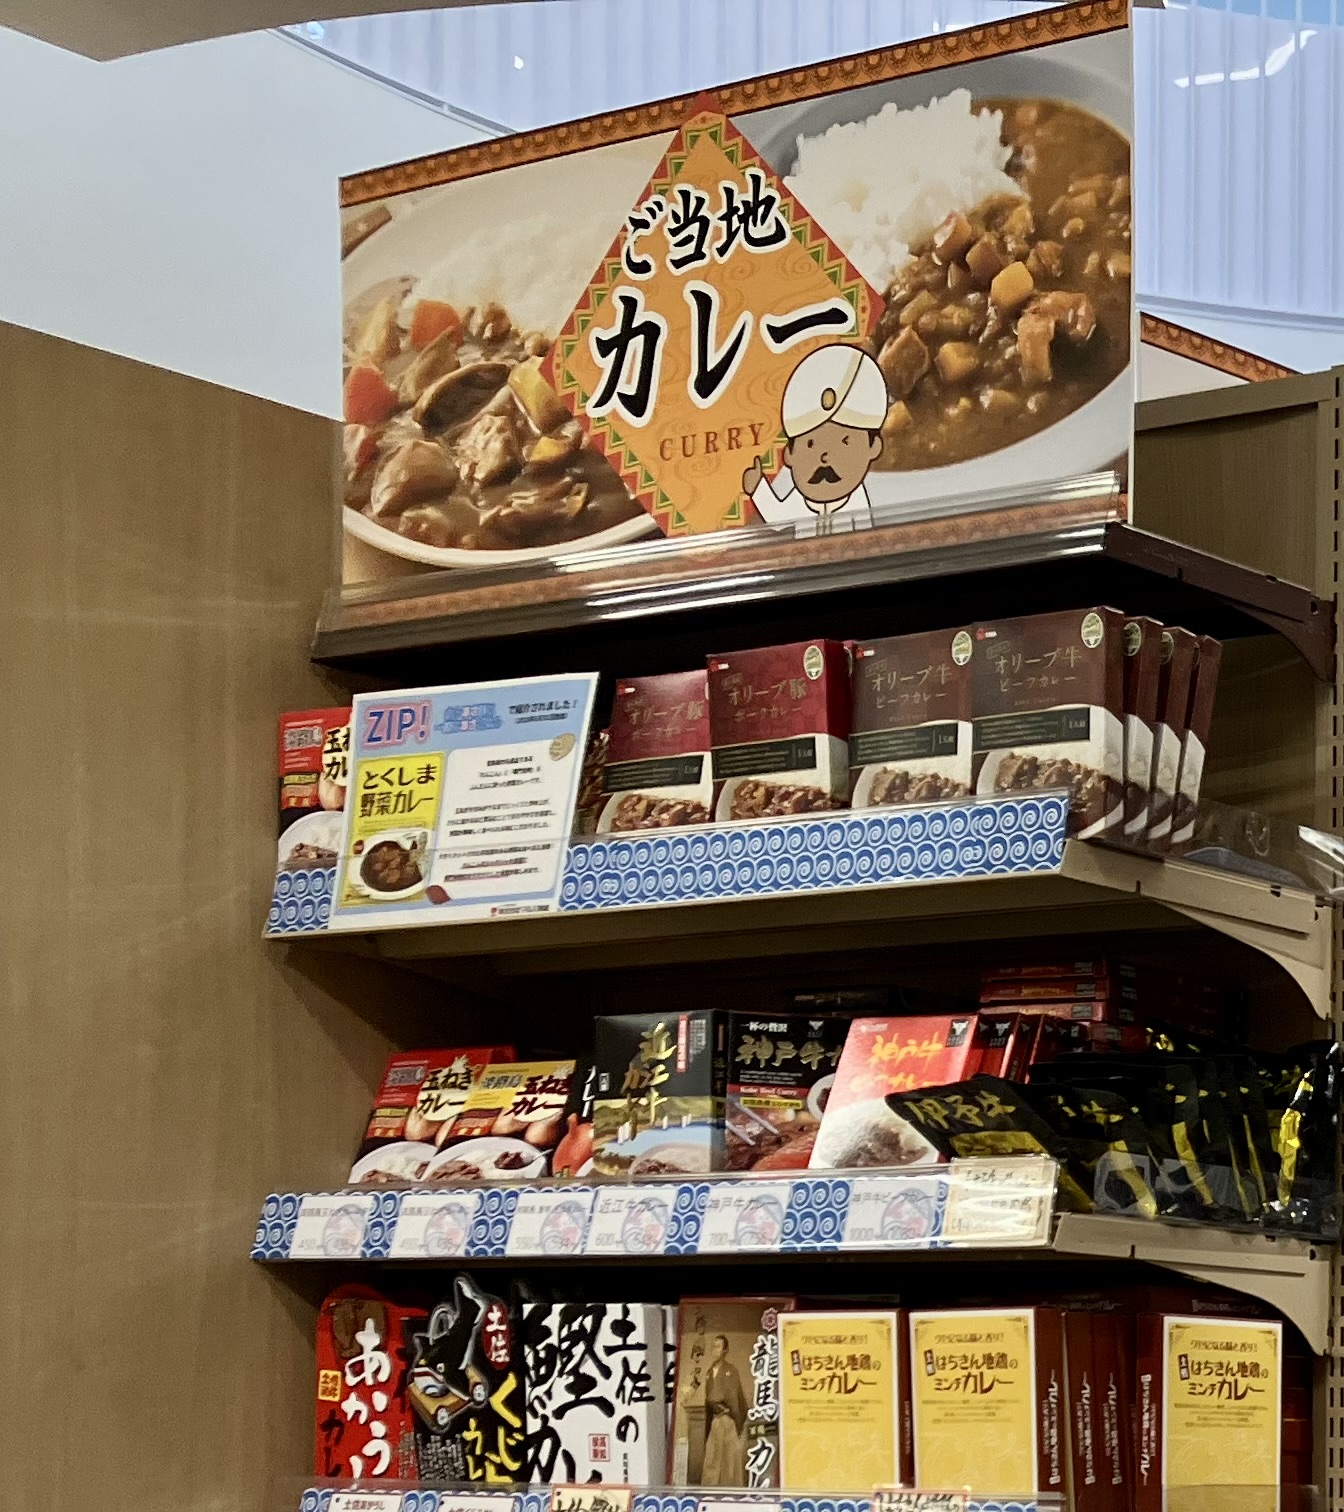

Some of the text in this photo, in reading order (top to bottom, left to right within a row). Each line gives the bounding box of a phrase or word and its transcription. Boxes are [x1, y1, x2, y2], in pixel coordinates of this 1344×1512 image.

[625, 176, 786, 276] ご当地
[593, 290, 850, 418] カレー
[659, 422, 765, 461] CURRY
[365, 704, 432, 744] ZIP!
[363, 764, 437, 788] とくしま
[357, 793, 434, 819] 野菜カレー
[417, 1091, 466, 1116] カレー
[509, 1096, 566, 1118] カレー
